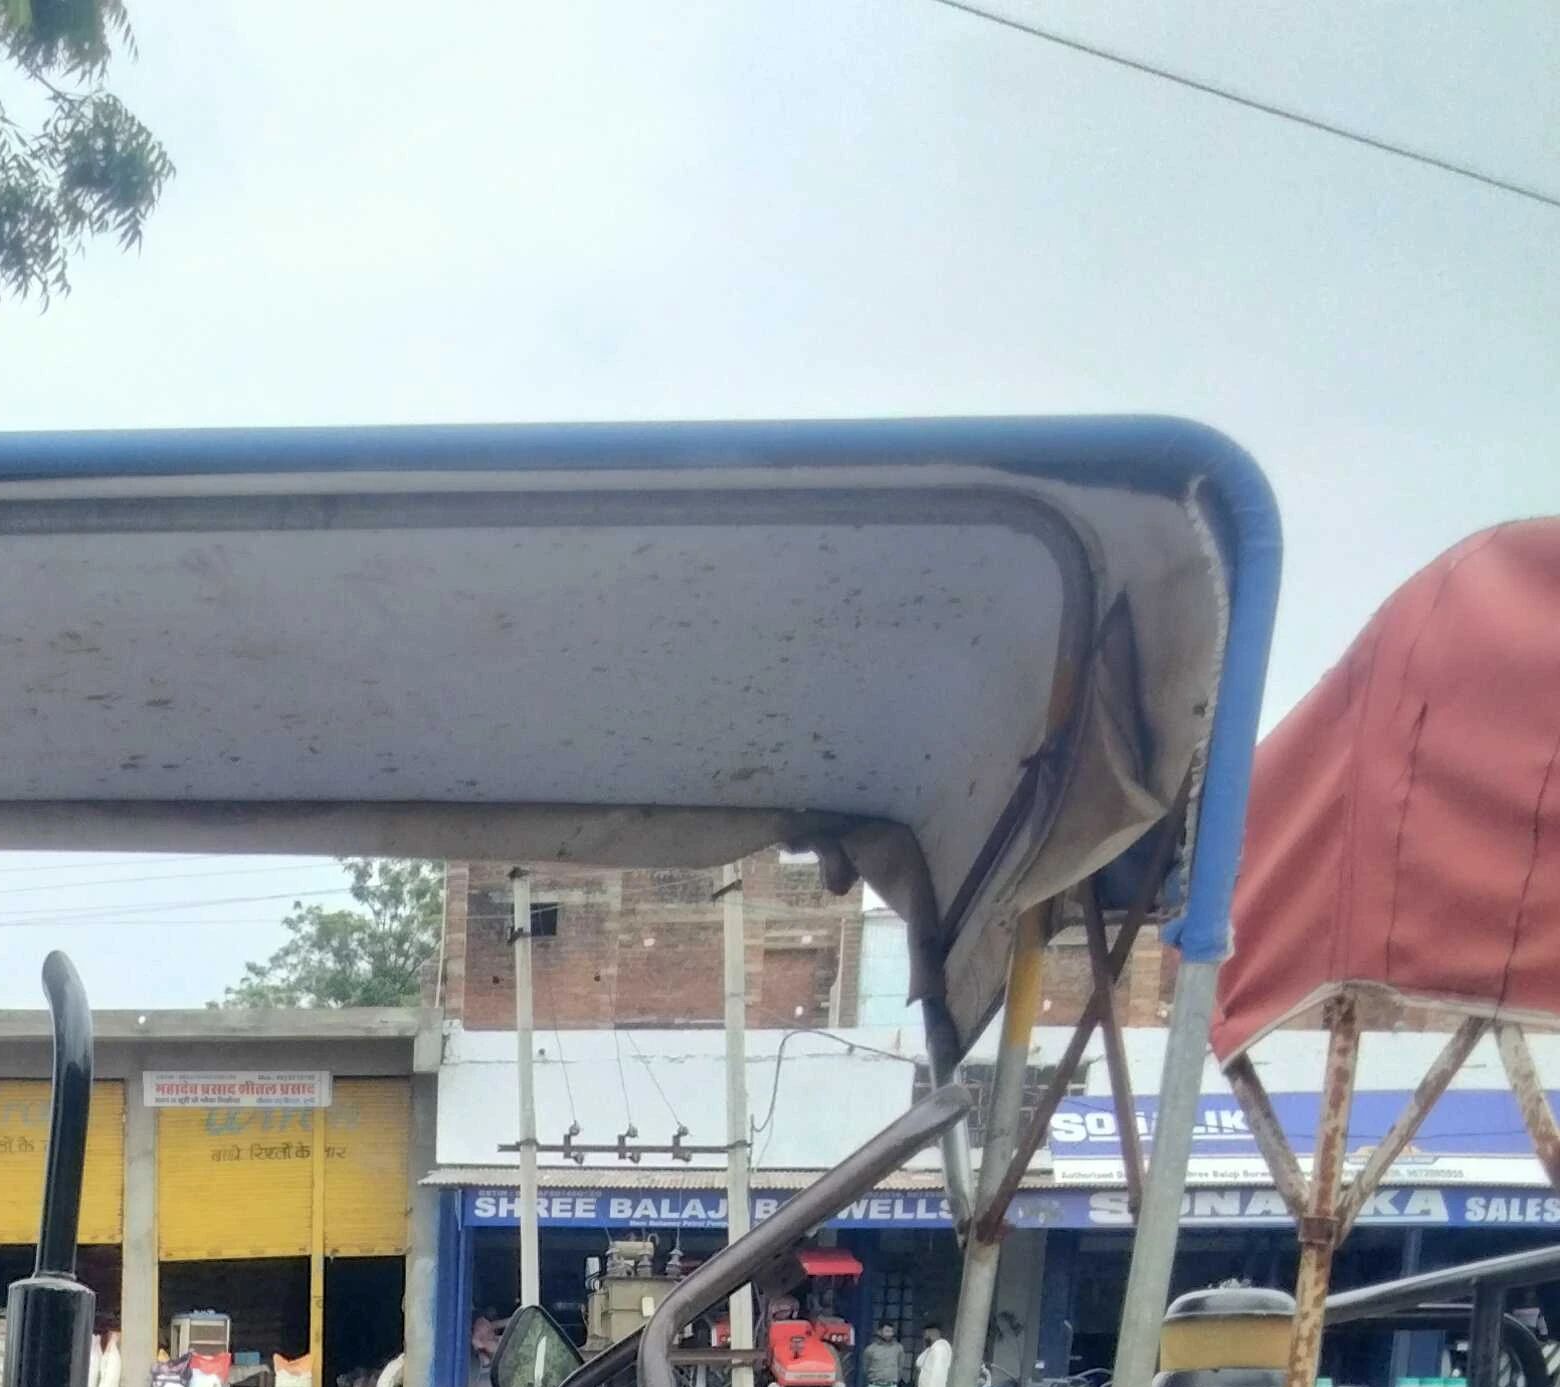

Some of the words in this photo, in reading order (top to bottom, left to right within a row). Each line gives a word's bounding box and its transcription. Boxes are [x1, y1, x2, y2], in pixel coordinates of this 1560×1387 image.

[609, 1198, 729, 1220] BALAJ
[1088, 1189, 1450, 1225] SNAKA
[1464, 1196, 1560, 1223] SALES
